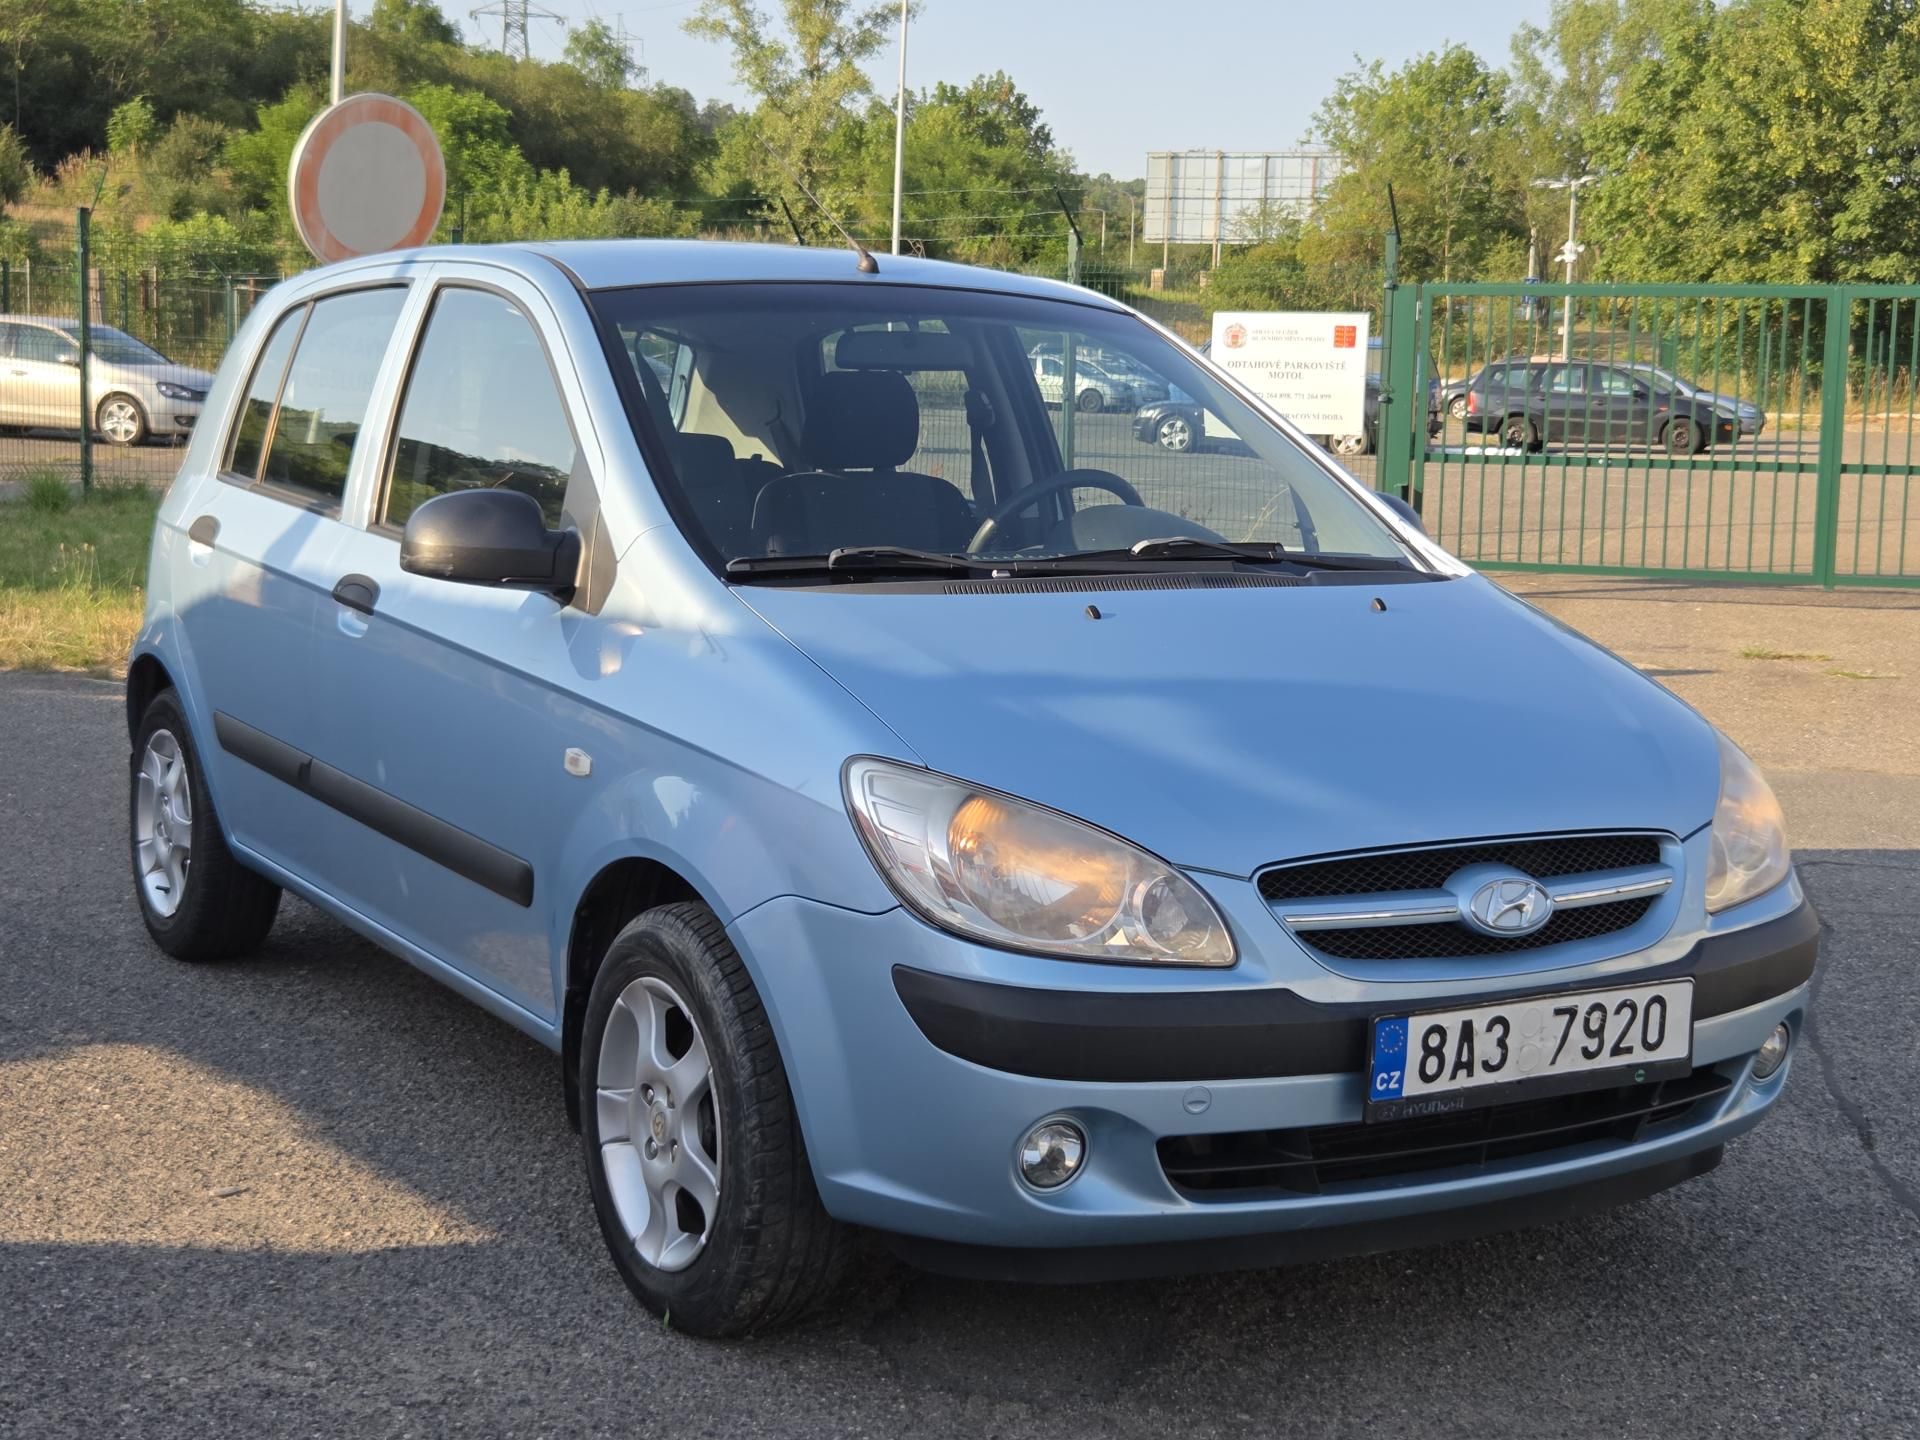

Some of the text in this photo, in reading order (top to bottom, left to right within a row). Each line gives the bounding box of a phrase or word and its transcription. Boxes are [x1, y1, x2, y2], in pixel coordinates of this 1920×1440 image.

[1227, 360, 1346, 370] ODTAHOVÉ PARKOVIŠTĚ
[1268, 371, 1304, 380] MOTOL
[1418, 994, 1667, 1084] 8A3 7920
[1376, 1071, 1401, 1092] CZ
